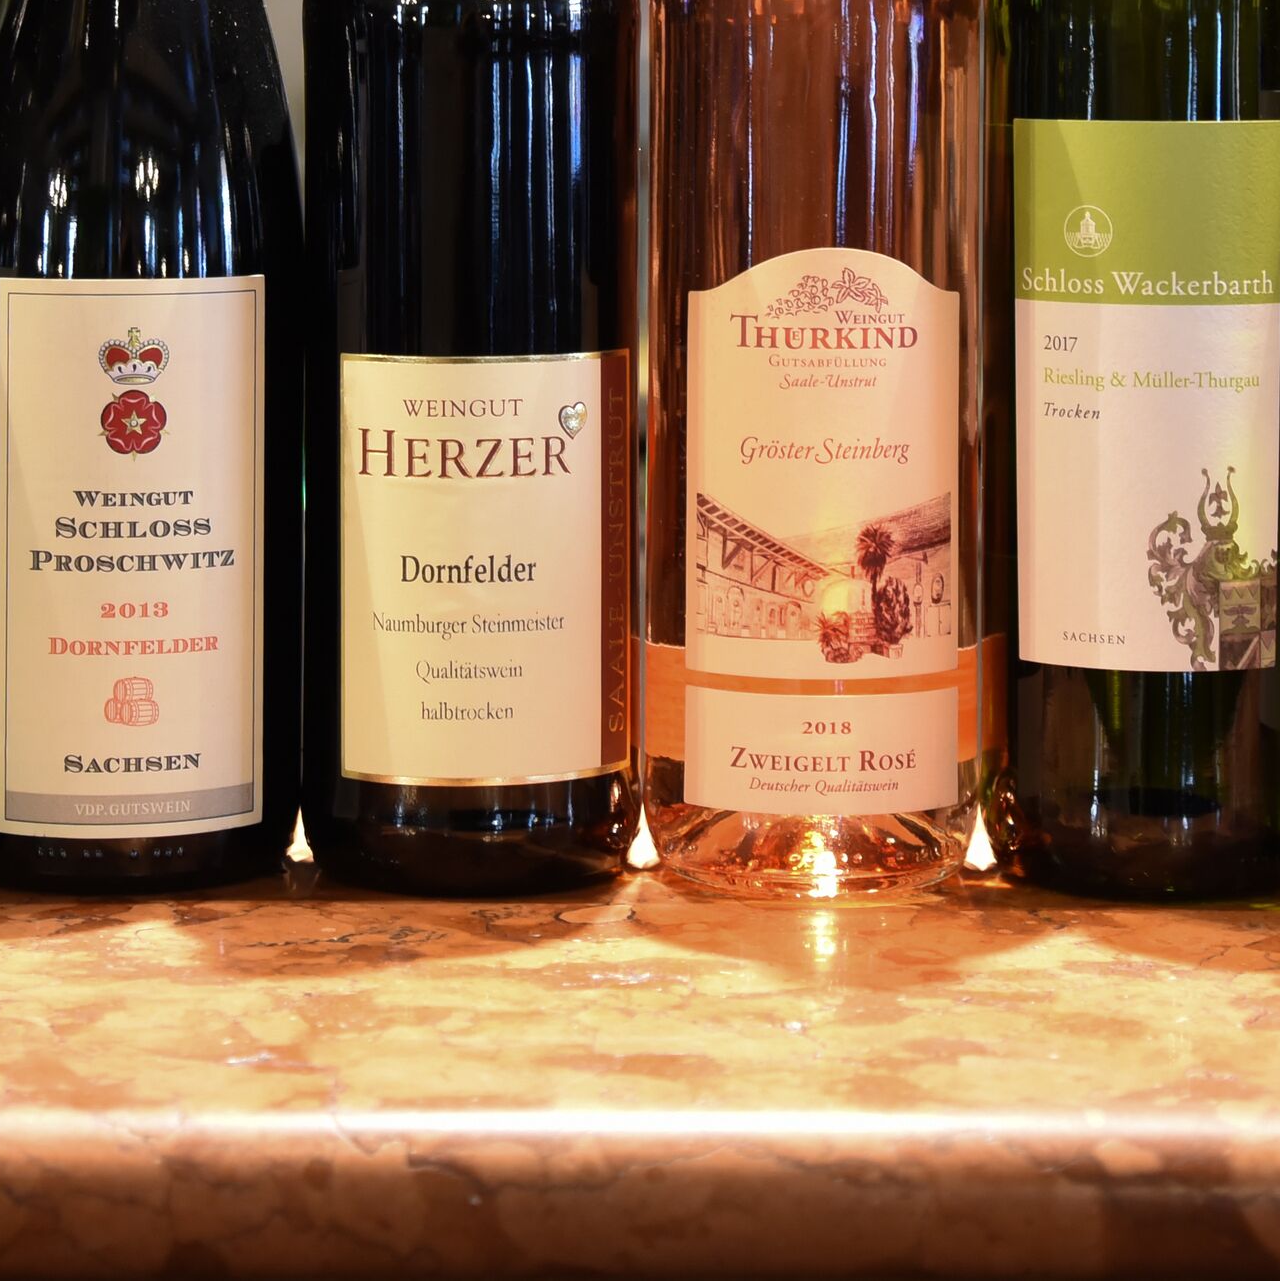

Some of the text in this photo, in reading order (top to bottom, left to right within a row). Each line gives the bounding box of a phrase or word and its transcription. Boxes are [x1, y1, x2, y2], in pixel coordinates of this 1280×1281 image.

[1022, 268, 1274, 296] Schloss Wackerbarth
[834, 310, 905, 325] WEINGUT
[1043, 334, 1078, 353] 2017
[769, 354, 887, 368] GUTSABFÜLLUNG
[779, 374, 878, 390] Saale-Unstrut
[1043, 367, 1260, 393] Riesling & Müller-Thurgau
[402, 398, 524, 418] WEINGUT
[1044, 402, 1100, 420] Trocken
[358, 428, 571, 479] HERZER
[739, 436, 911, 465] Gröster Steinberg
[73, 490, 194, 507] WEINGUT
[55, 515, 212, 540] SCHLOSS
[29, 548, 235, 573] PROSCHWITZ
[400, 554, 537, 584] Dornfelder
[100, 601, 170, 619] 2013
[372, 611, 565, 641] Naumburger Steinmeister
[48, 634, 219, 658] DORNFELDER
[1062, 630, 1126, 646] SACHSEN
[415, 659, 523, 684] Qualitätswein
[421, 701, 514, 721] halbtrocken
[802, 721, 852, 735] 2018
[63, 752, 202, 774] SACHSEN
[730, 746, 917, 772] ZWEIGELT ROSÉ
[749, 777, 900, 796] Deutscher Qualitätswein
[74, 799, 192, 816] VDP.GUTSWEIN
